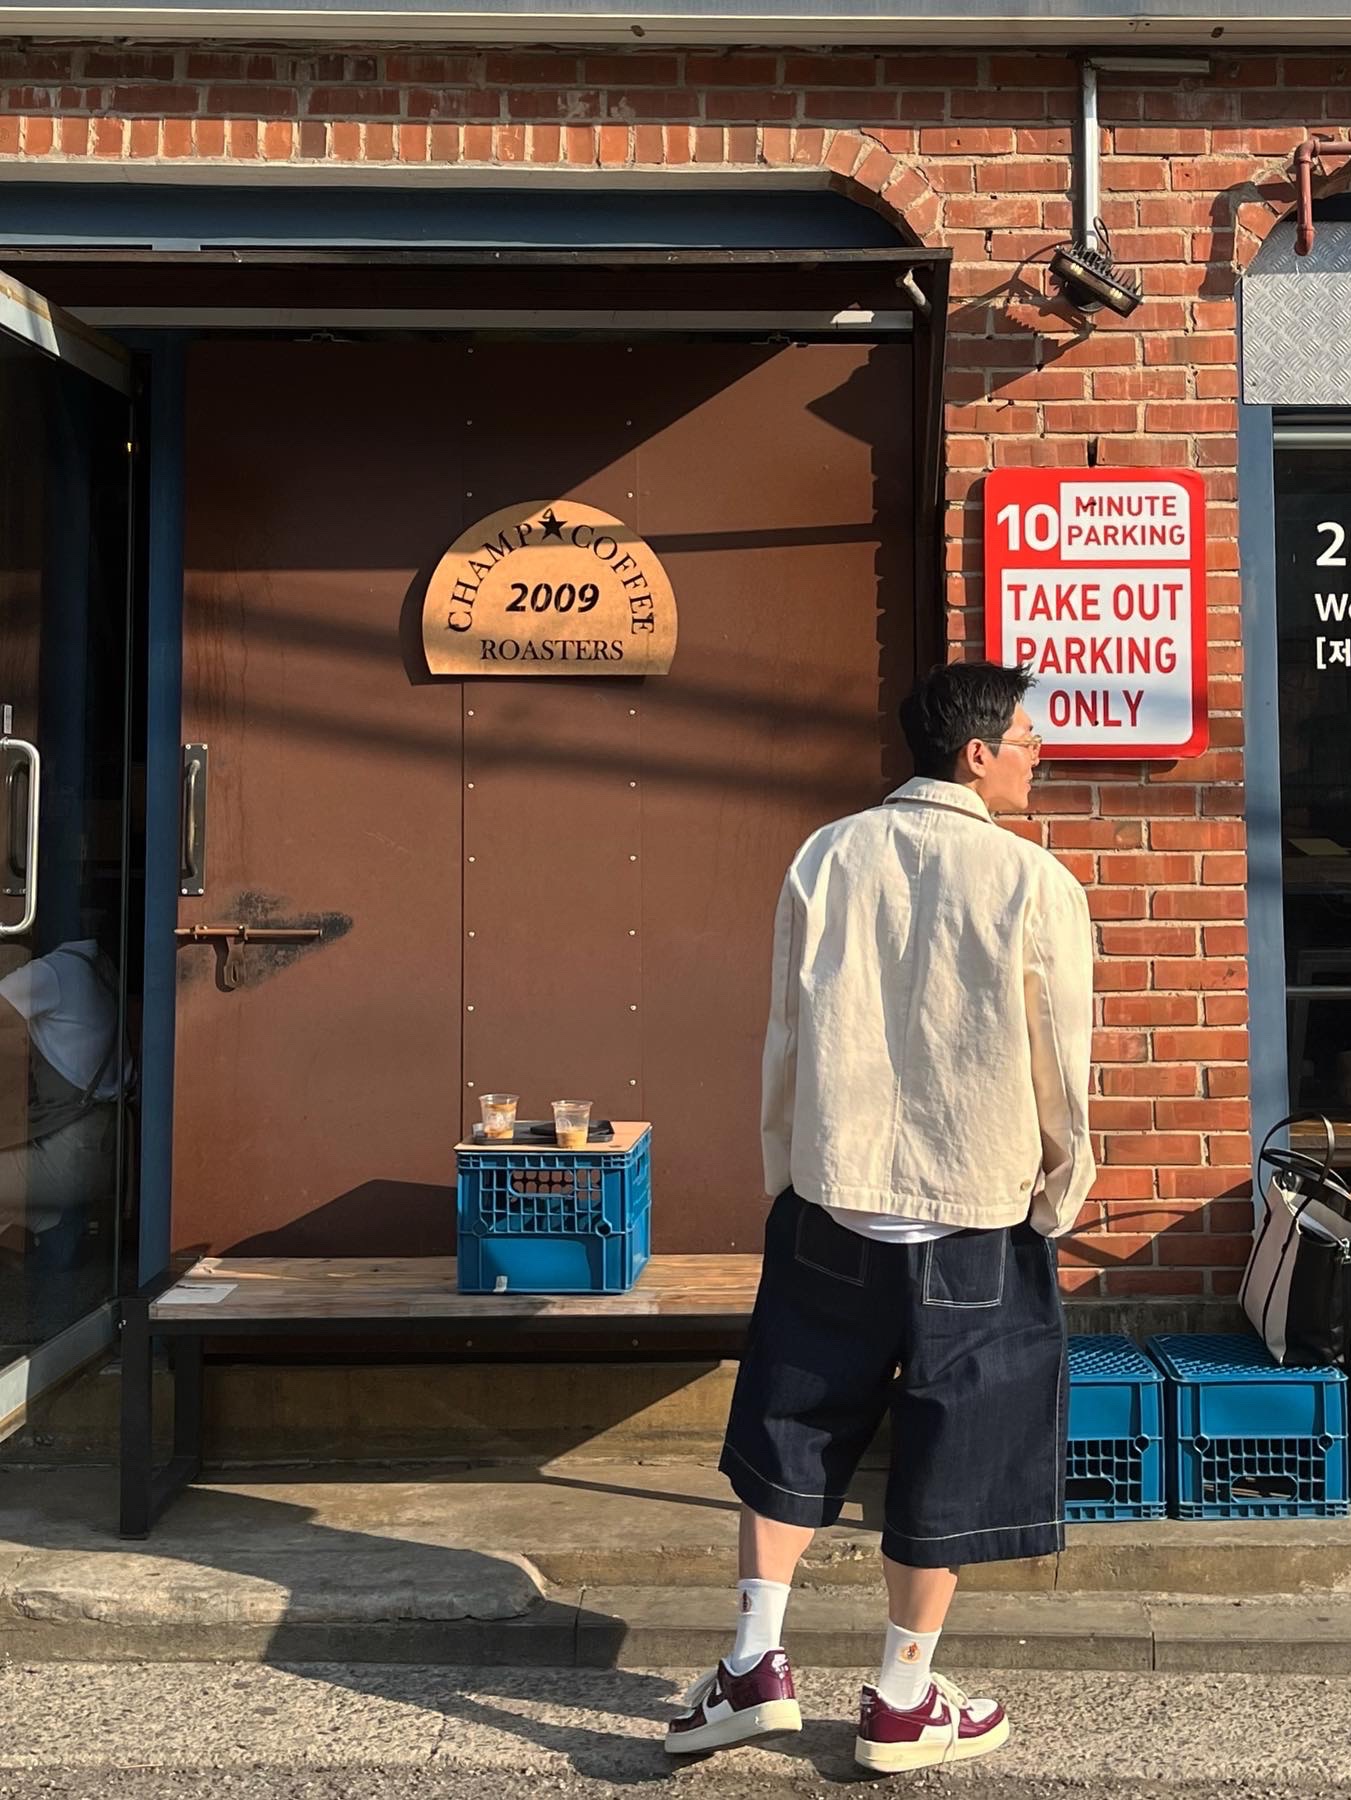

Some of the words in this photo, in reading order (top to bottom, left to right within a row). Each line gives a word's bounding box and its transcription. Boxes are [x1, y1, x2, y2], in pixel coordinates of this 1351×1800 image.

[1075, 495, 1177, 517] MINUTE
[997, 503, 1059, 551] 10
[1067, 525, 1185, 546] PARKING
[448, 522, 533, 633] CHAMP
[571, 524, 655, 635] COFFEE
[505, 582, 600, 613] 2009
[1007, 584, 1101, 621] TAKE
[1113, 583, 1183, 621] OUT
[1314, 593, 1351, 622] W
[480, 639, 624, 661] ROASTERS
[1016, 636, 1177, 674] PARKING
[1050, 690, 1144, 727] ONLY
